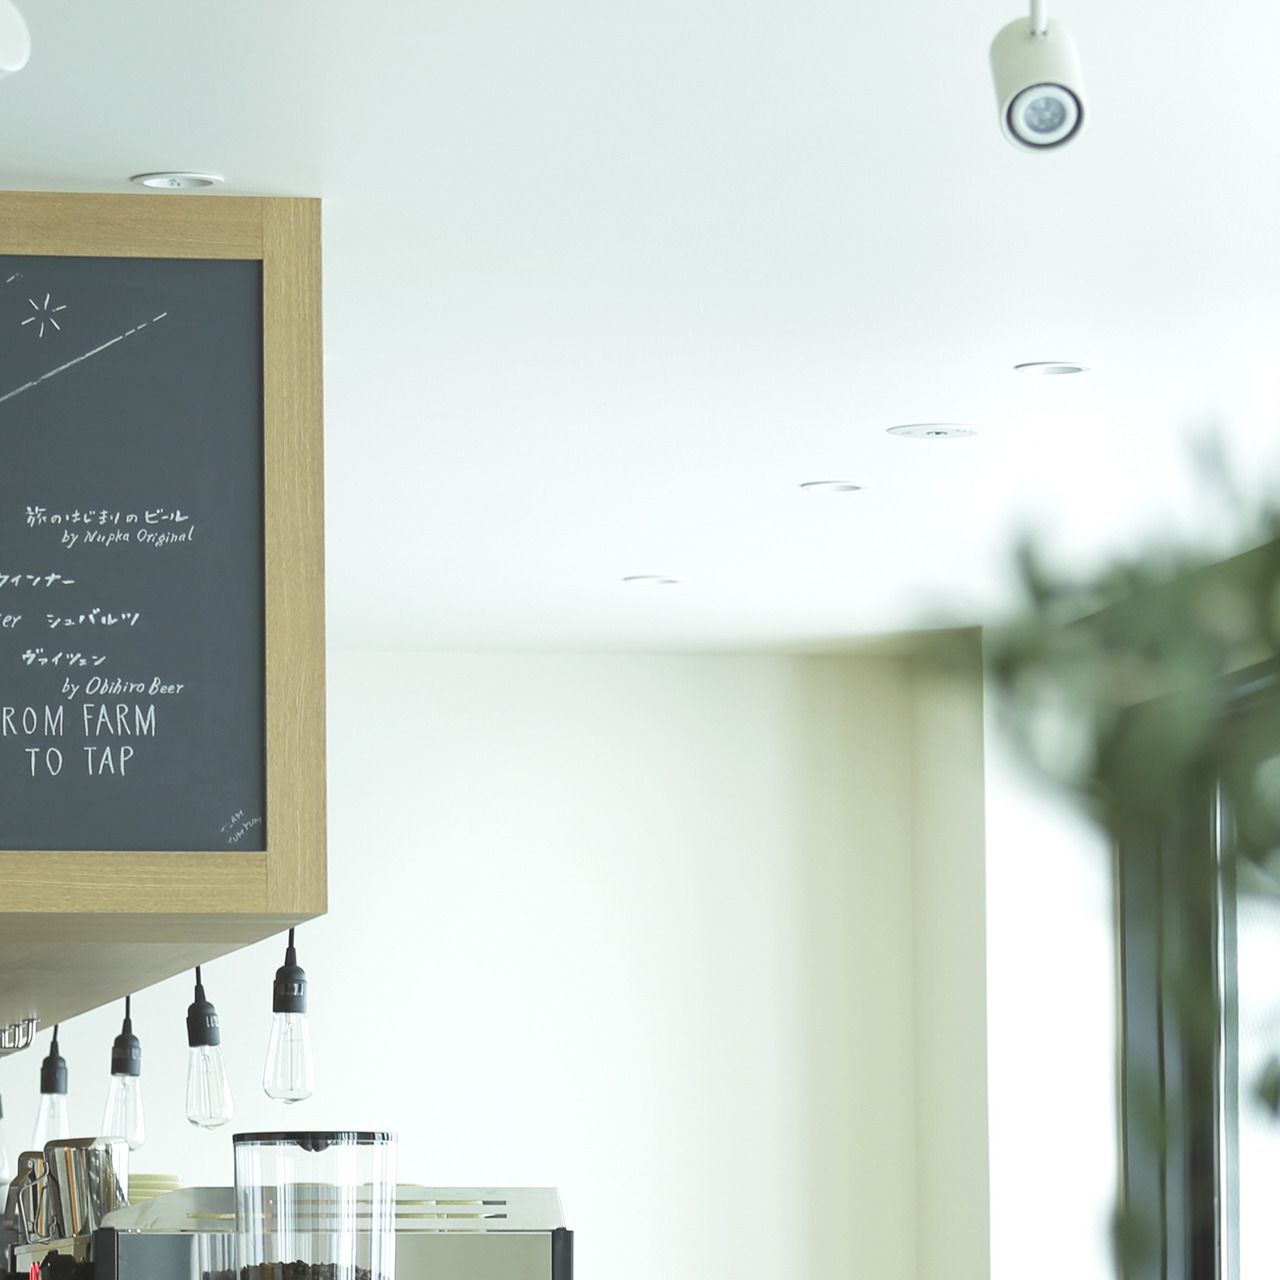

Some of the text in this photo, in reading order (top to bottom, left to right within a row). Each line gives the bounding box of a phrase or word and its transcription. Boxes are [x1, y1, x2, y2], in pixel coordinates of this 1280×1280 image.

[61, 525, 194, 549] by Nupka Original
[62, 676, 184, 700] by Obihiro Beer
[83, 704, 155, 737] FARM
[25, 746, 133, 776] TO TAP
